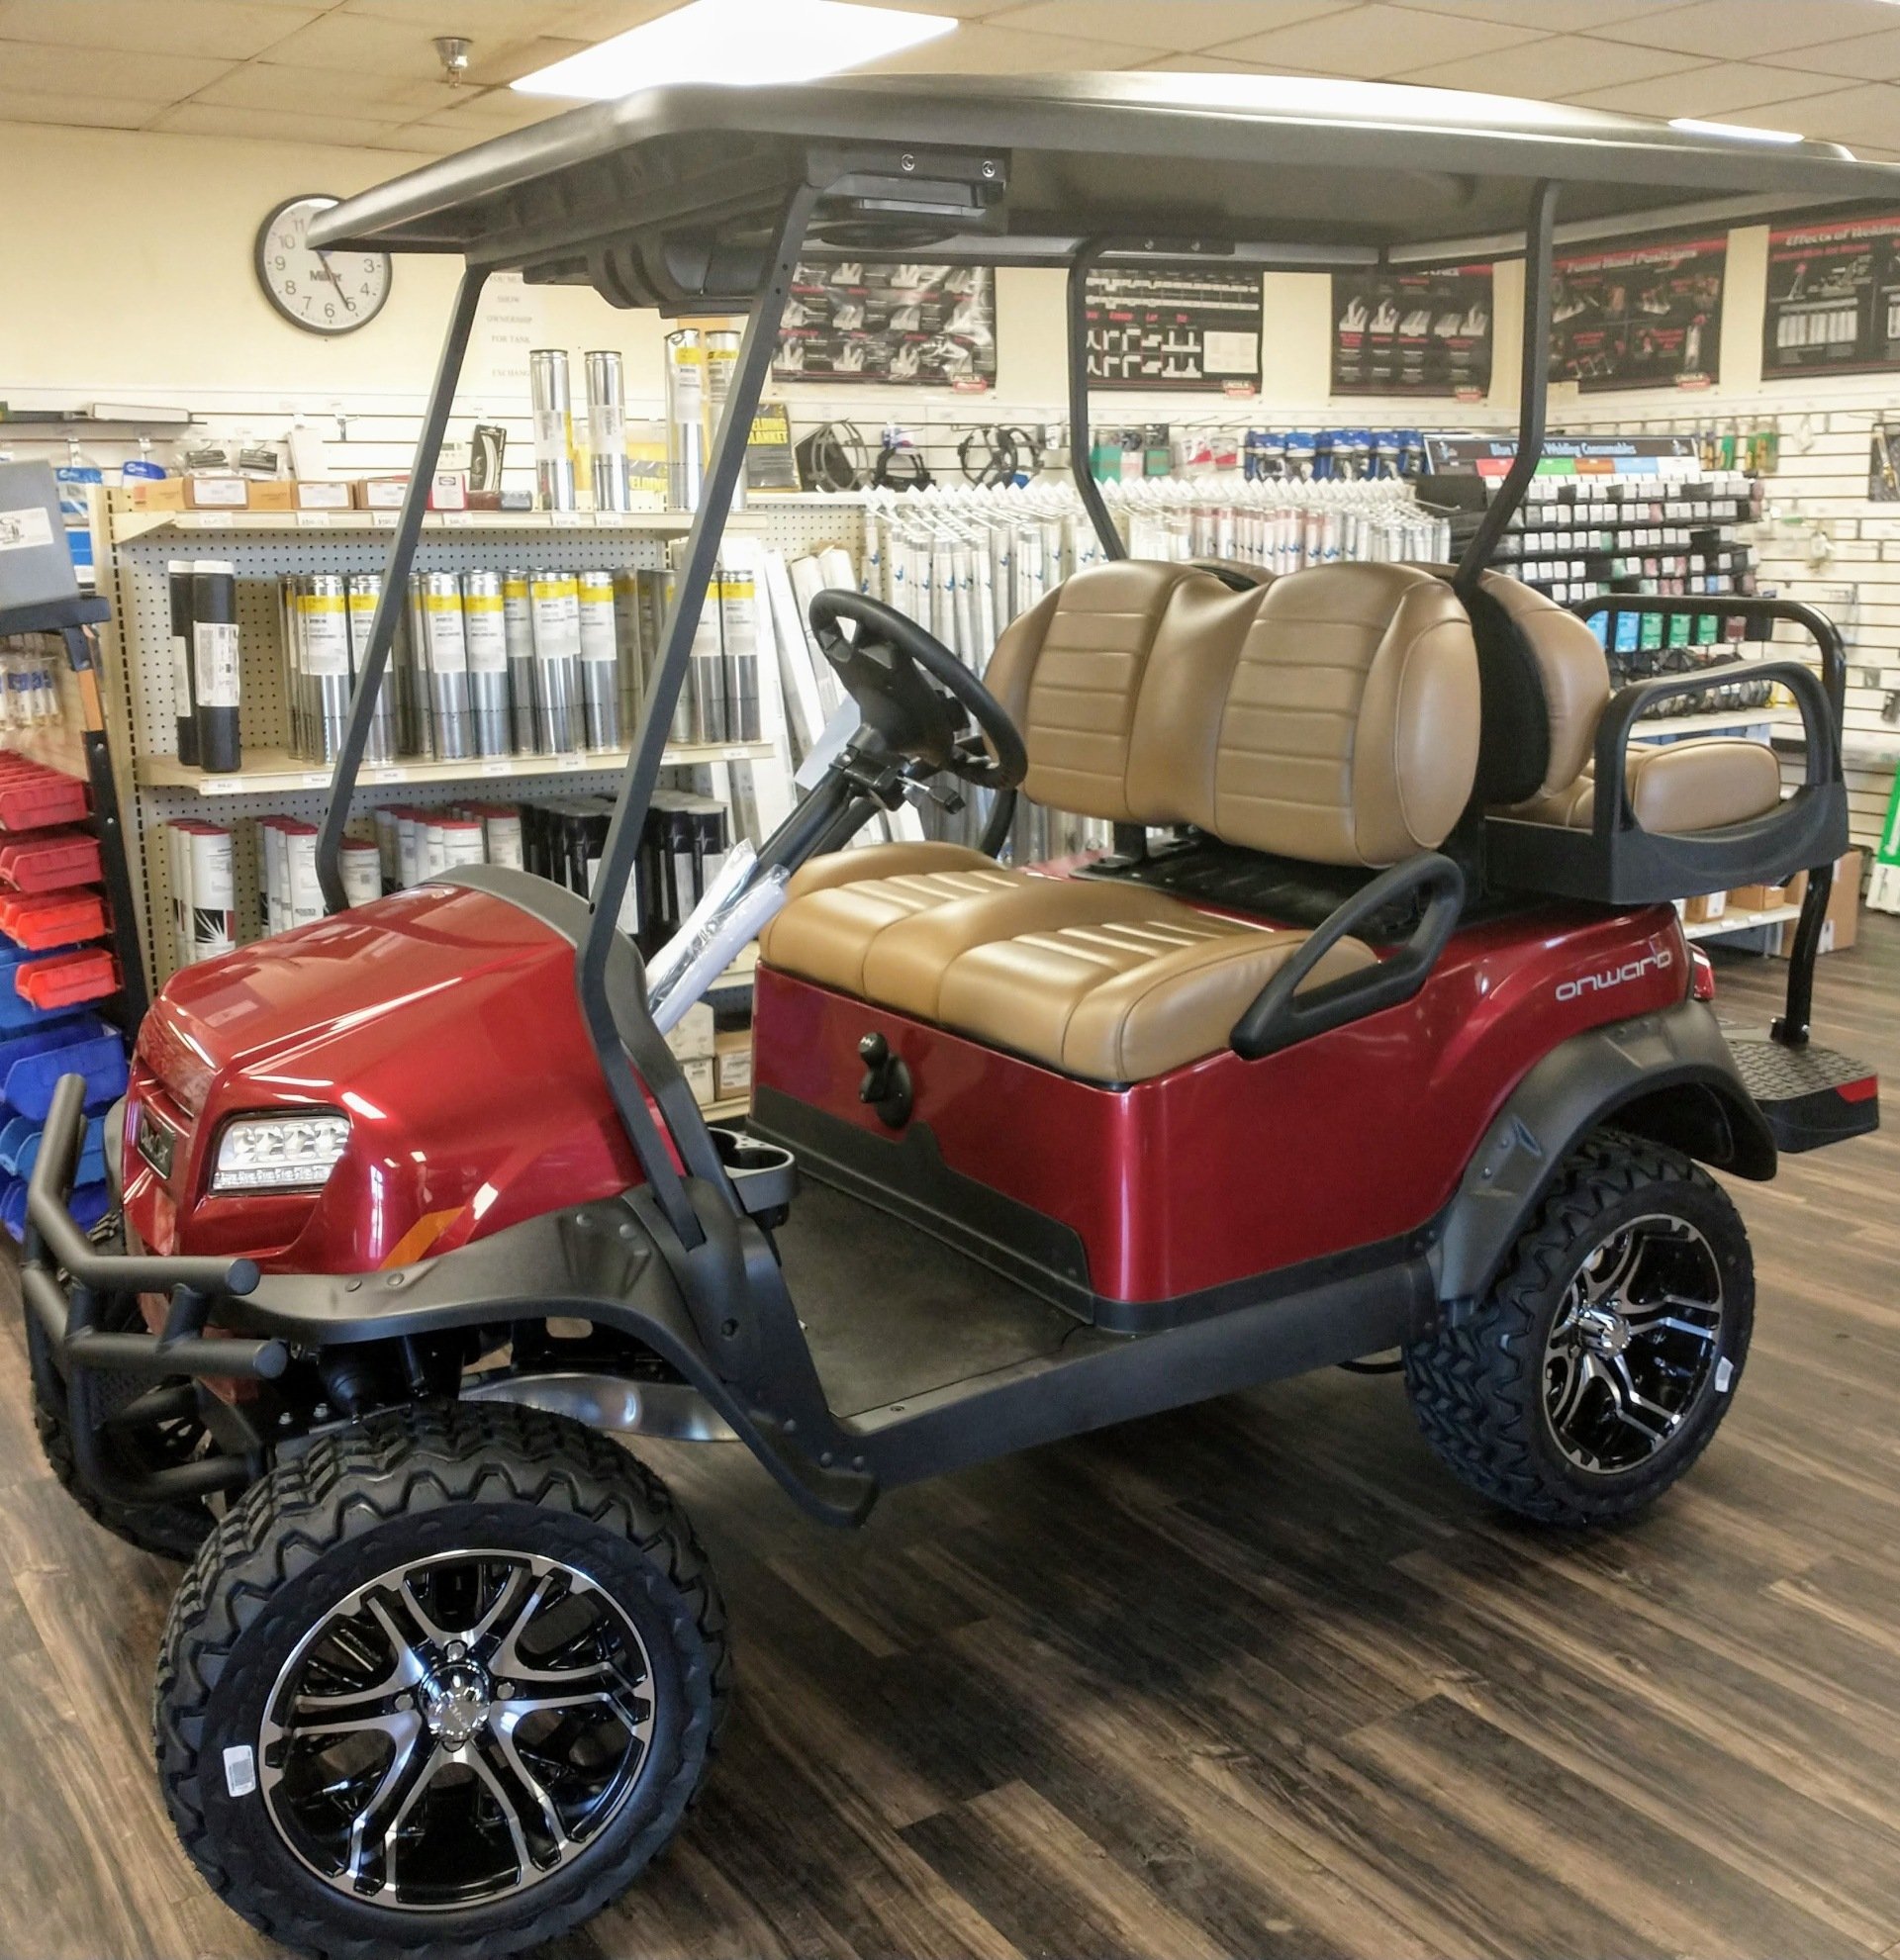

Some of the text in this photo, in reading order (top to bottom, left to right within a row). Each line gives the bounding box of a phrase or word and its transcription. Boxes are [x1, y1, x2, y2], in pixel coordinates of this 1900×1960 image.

[294, 219, 305, 232] 11
[279, 233, 295, 249] 10
[274, 255, 286, 271] 9
[363, 258, 375, 273] 3
[284, 280, 296, 295] 8
[359, 282, 370, 296] 4
[302, 296, 312, 310] 7
[324, 303, 335, 318] 6
